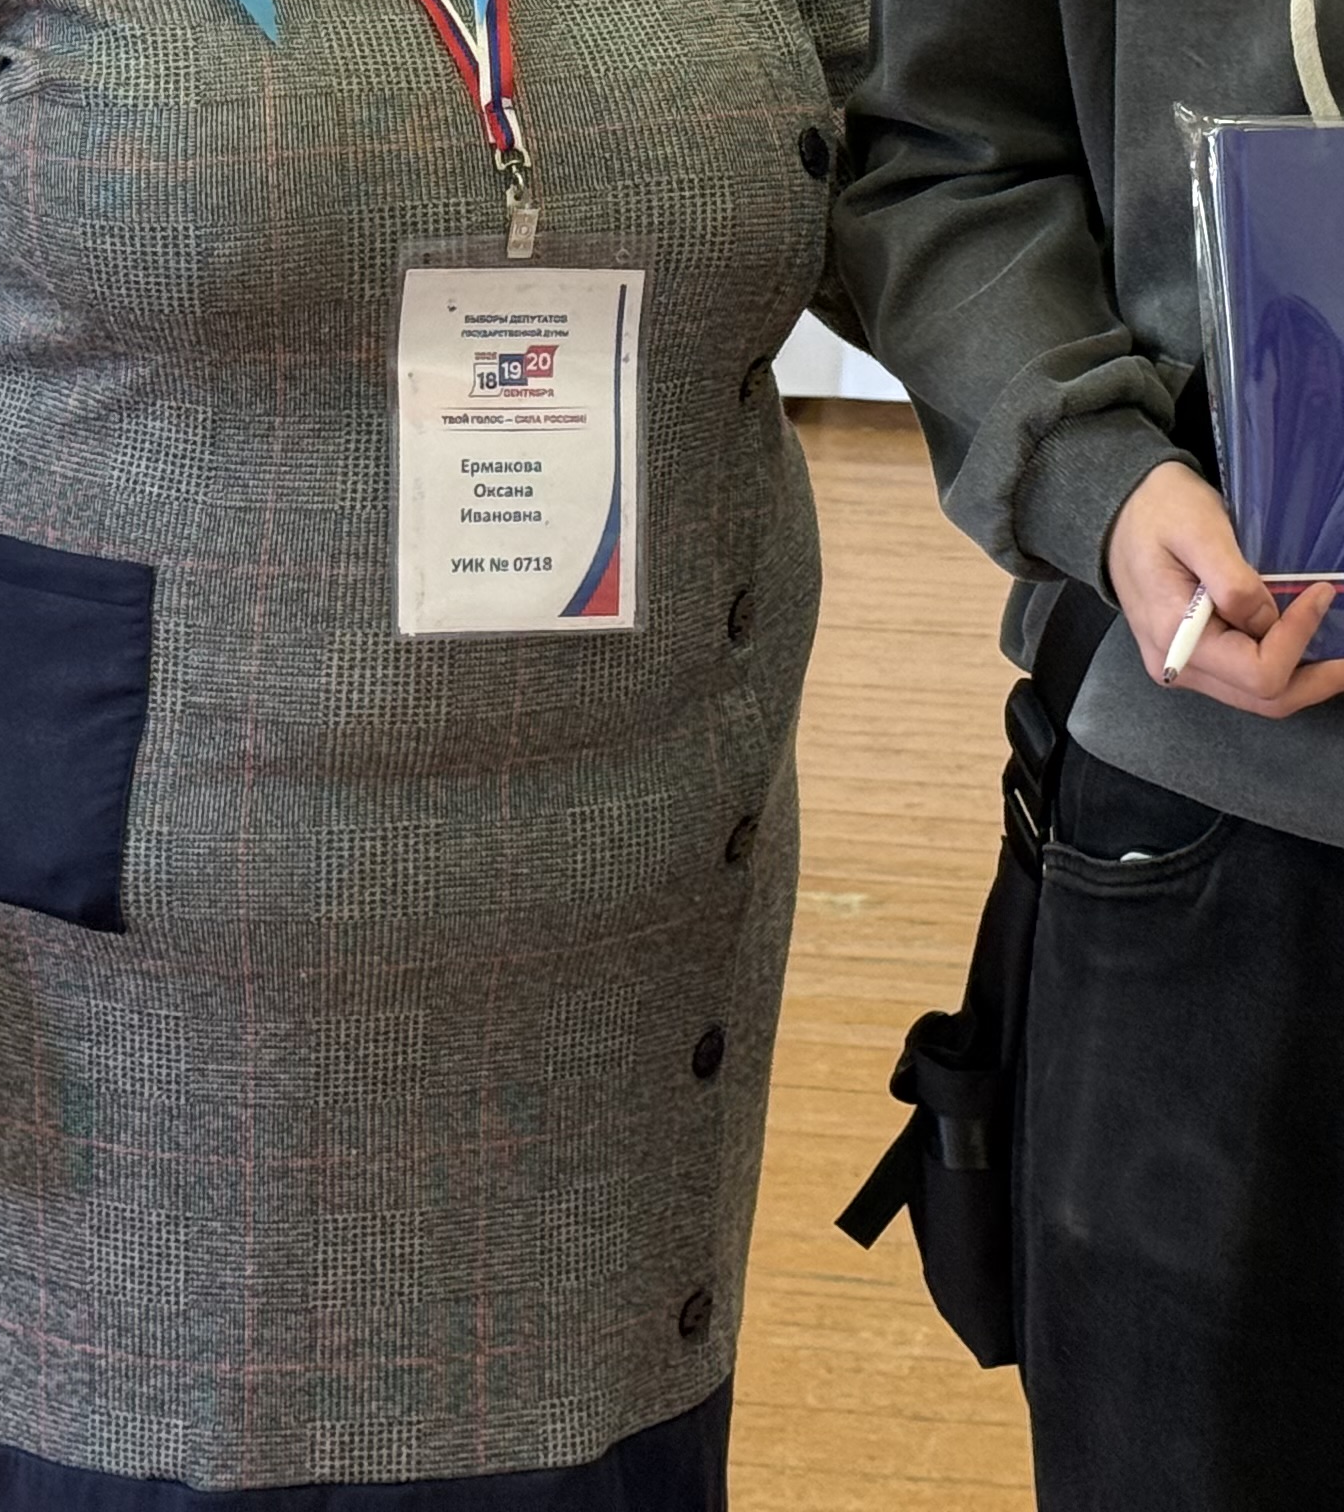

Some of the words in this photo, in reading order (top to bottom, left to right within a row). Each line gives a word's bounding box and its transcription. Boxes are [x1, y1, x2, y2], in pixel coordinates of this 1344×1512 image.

[509, 314, 568, 325] ДЕПУТАТОВ
[477, 371, 498, 390] 18
[501, 361, 522, 379] 19
[526, 352, 551, 371] 20
[442, 413, 469, 425] ТВОЙ
[471, 415, 504, 425] ГОЛОС
[460, 458, 543, 478] Ермакова
[473, 483, 534, 498] Оксана
[460, 507, 543, 524] Ивановна
[451, 557, 485, 573] УИК
[489, 557, 509, 572] №
[513, 556, 553, 572] 0718
